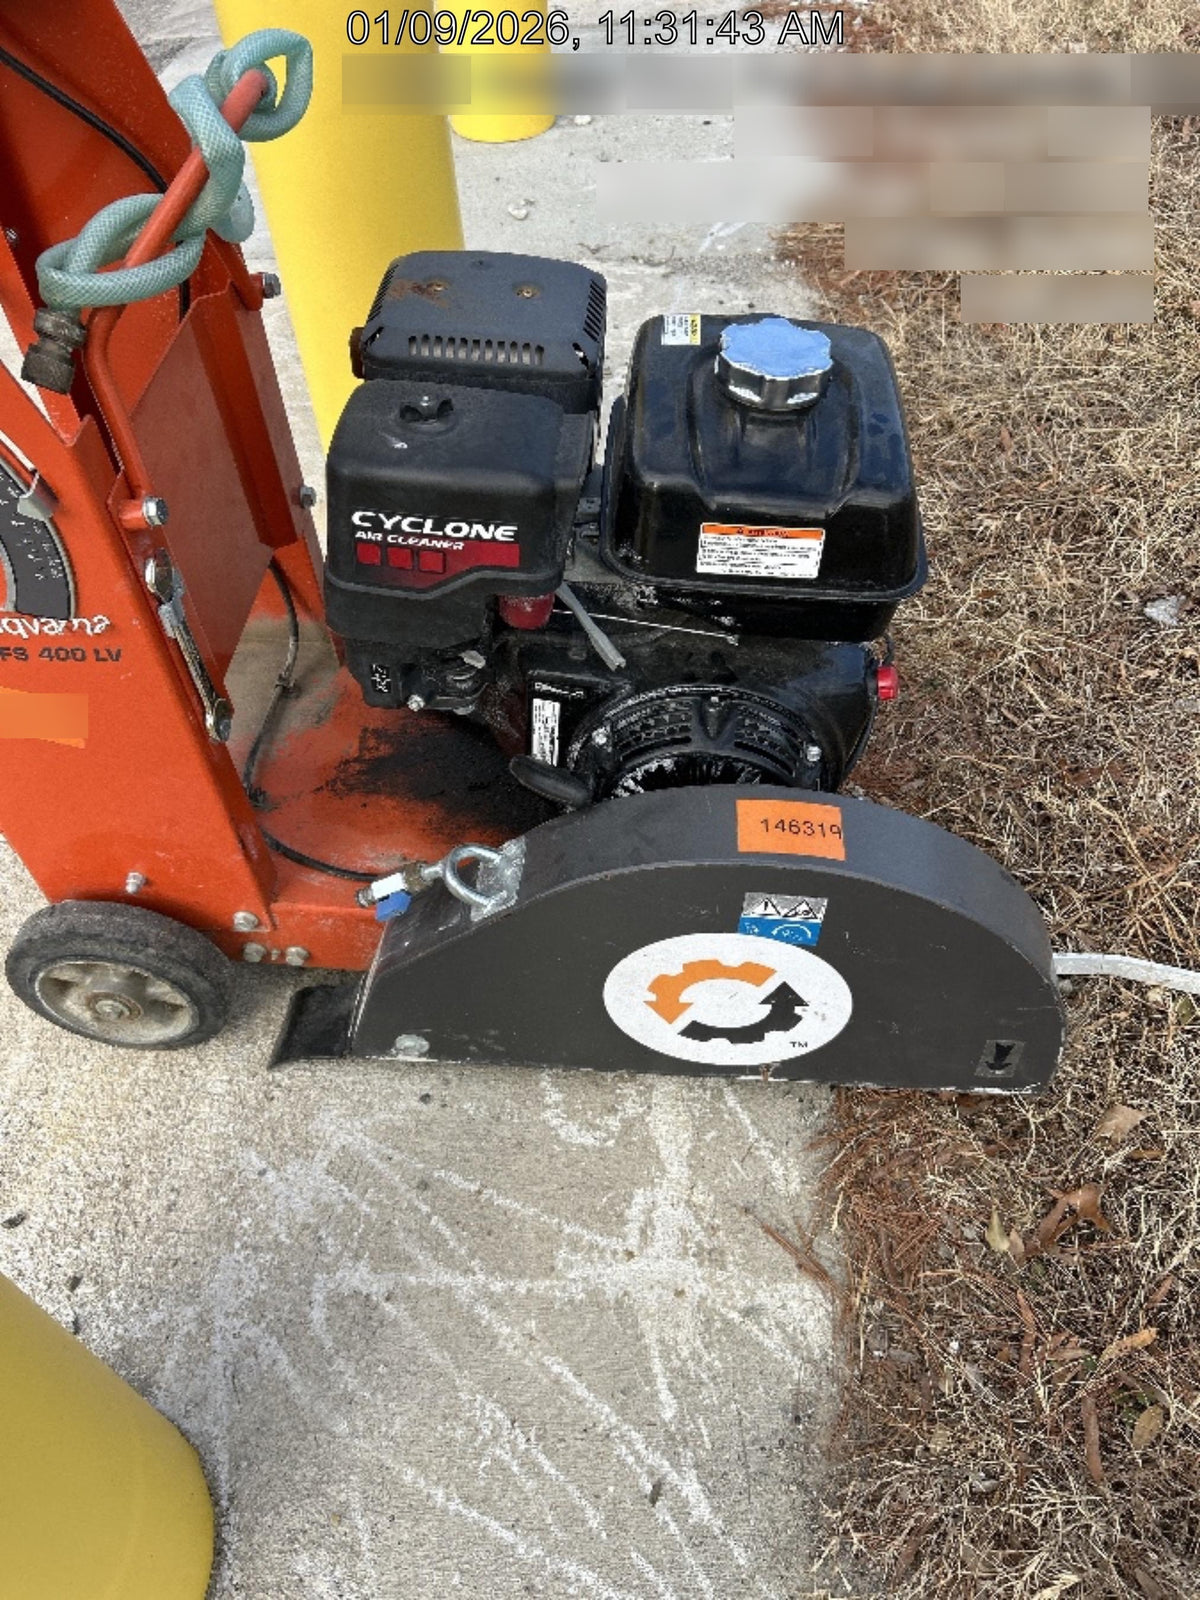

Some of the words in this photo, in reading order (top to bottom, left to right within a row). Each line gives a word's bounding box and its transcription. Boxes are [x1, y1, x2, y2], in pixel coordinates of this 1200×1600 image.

[351, 511, 518, 541] CYCLONE
[355, 531, 383, 542] AIR
[387, 534, 465, 551] CLEANER
[0, 615, 110, 639] qvarna
[0, 646, 29, 661] FS
[39, 646, 86, 662] 400
[93, 647, 122, 662] LV
[760, 818, 842, 840] 146319
